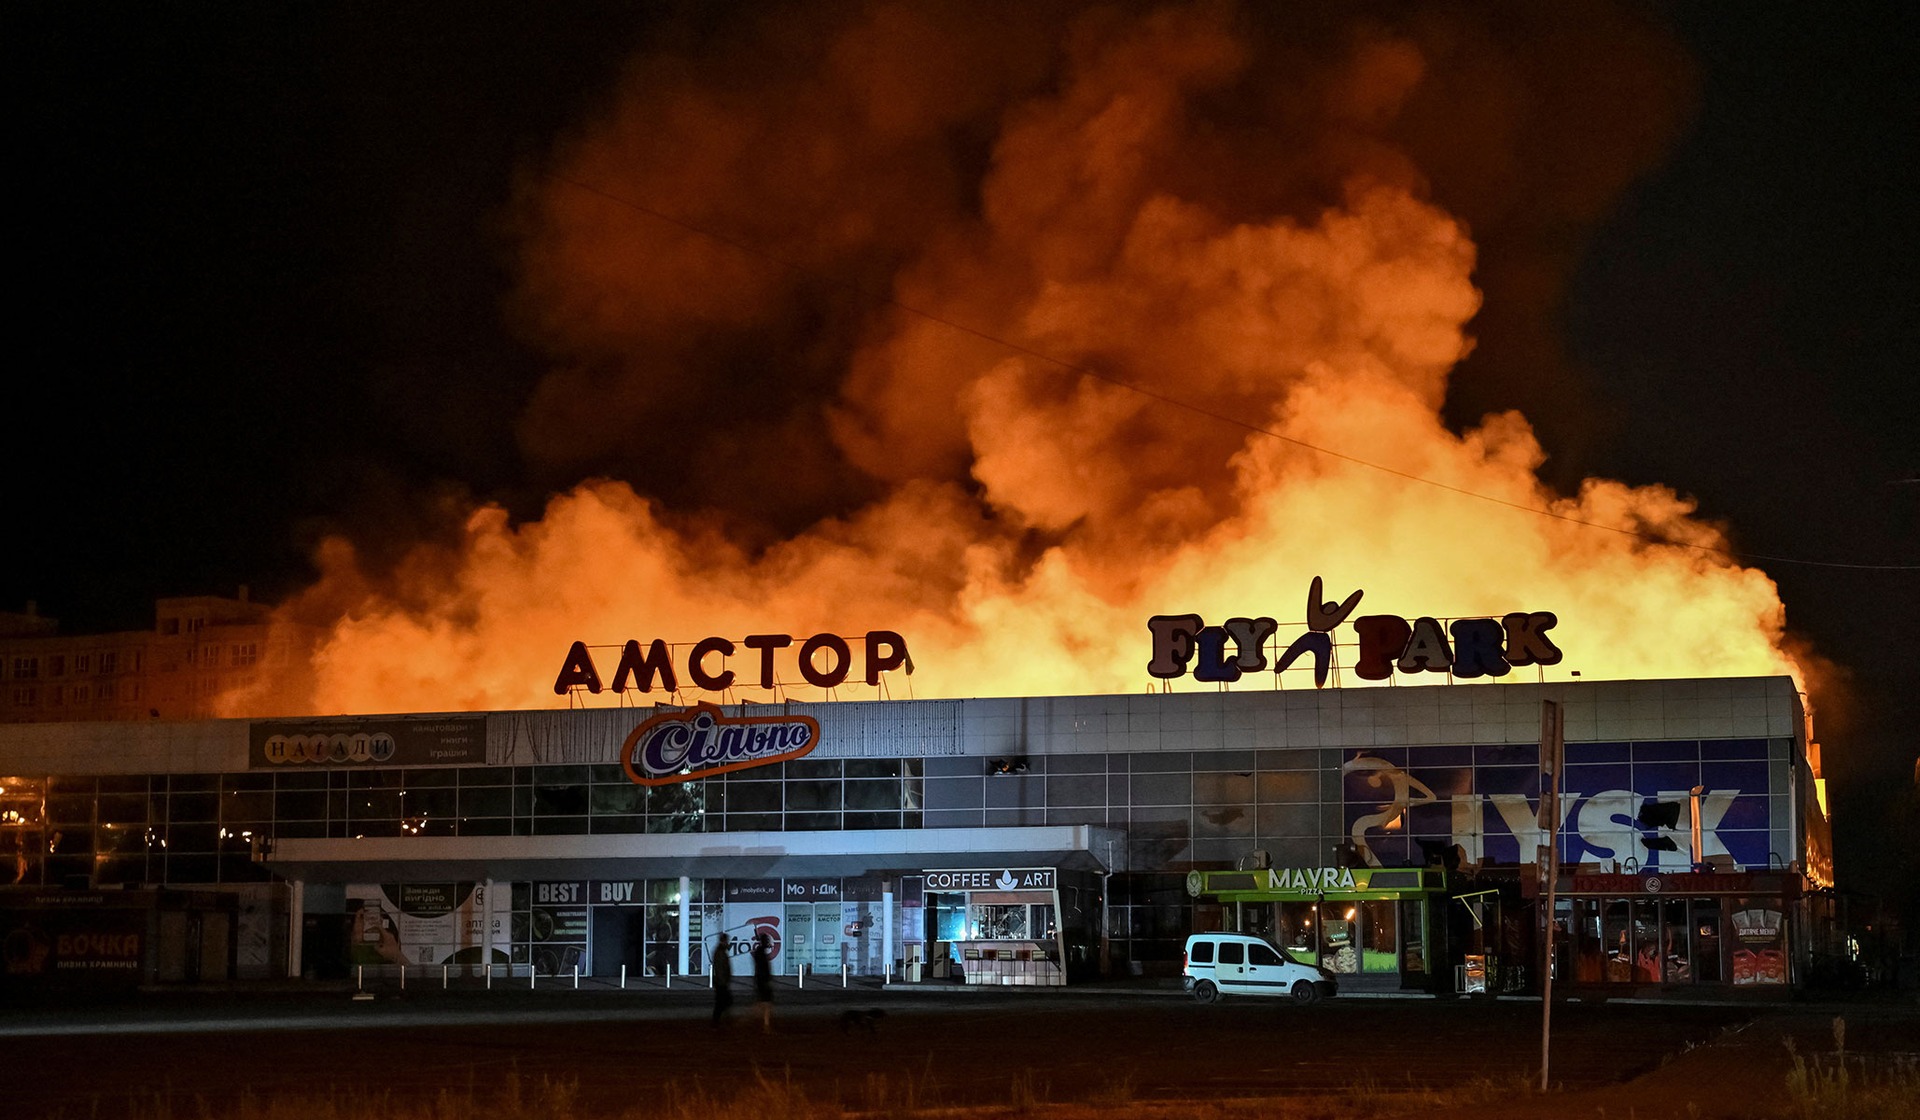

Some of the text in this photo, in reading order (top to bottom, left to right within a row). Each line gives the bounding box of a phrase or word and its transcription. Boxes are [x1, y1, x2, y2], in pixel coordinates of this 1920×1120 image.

[1148, 612, 1563, 682] FLY PARK
[554, 630, 907, 695] АМСТОР
[641, 715, 811, 775] Сільпо
[926, 872, 1051, 887] COFFEE ART
[1268, 867, 1356, 888] MAVRA
[538, 882, 634, 902] BEST BUY
[1300, 888, 1324, 896] PIZZA
[56, 934, 139, 956] БОЧКА
